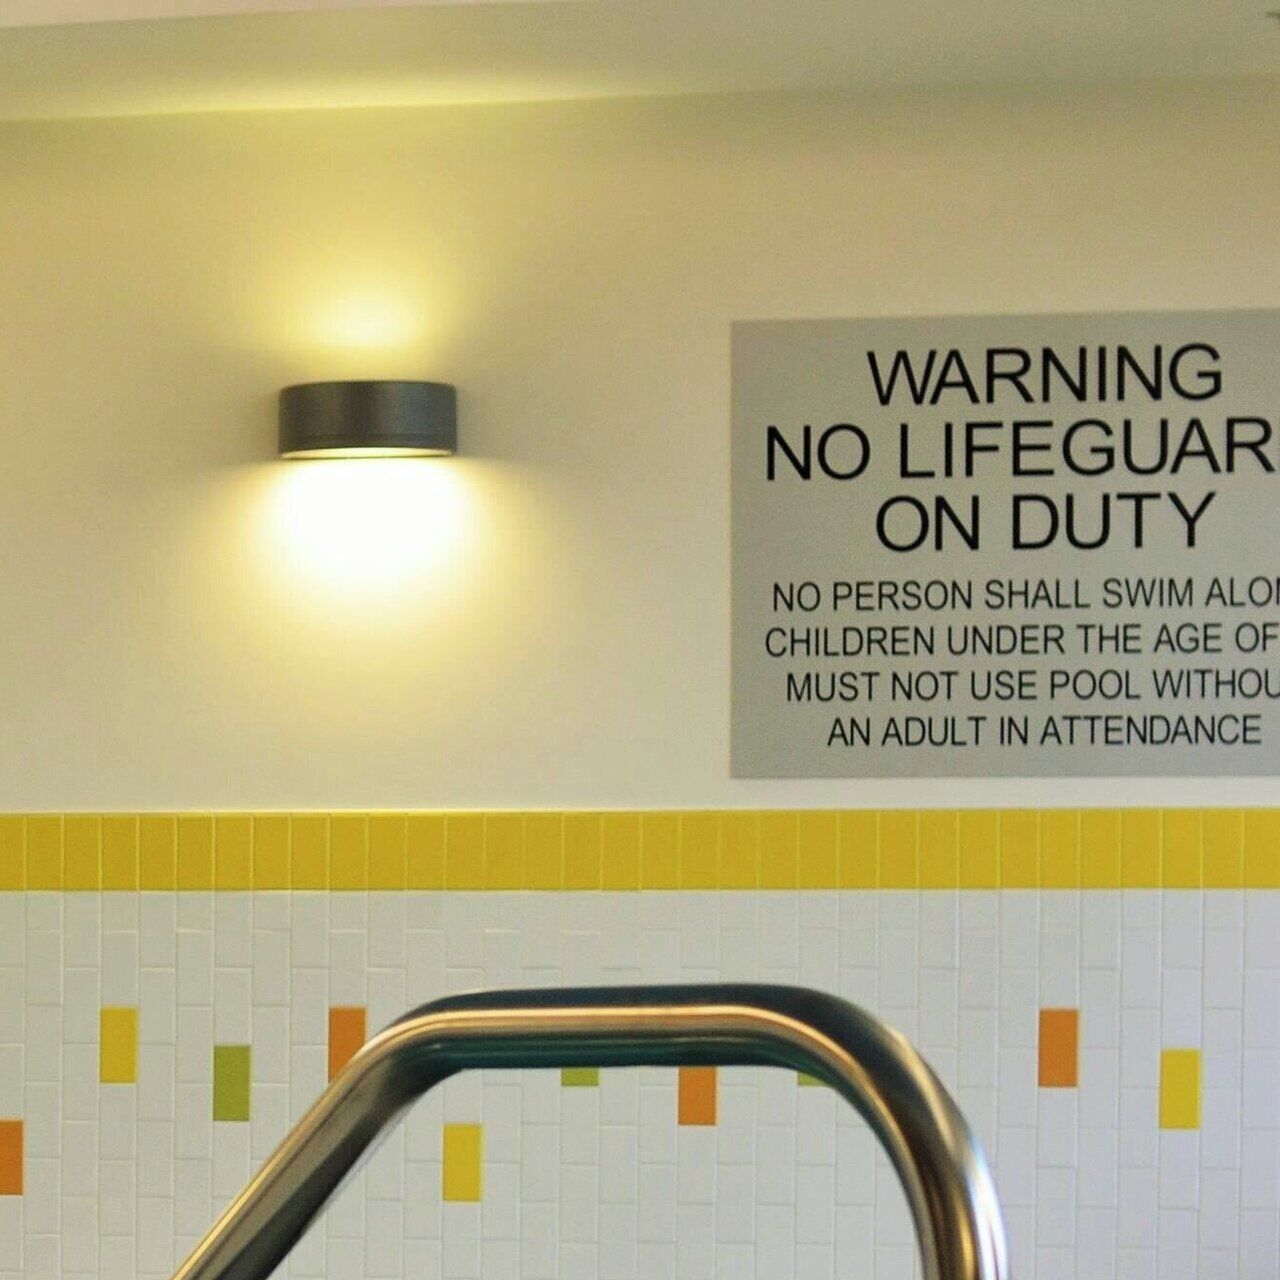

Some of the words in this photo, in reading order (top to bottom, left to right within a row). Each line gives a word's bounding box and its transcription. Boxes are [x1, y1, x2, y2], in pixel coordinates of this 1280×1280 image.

[867, 343, 1221, 406] WARNING
[767, 424, 870, 481] NO
[900, 417, 1280, 478] LIFEGUAR
[876, 495, 979, 552] ON
[1013, 492, 1215, 550] DUTY
[774, 582, 820, 611] NO
[833, 580, 971, 611] PERSON
[985, 579, 1090, 609] SHALL
[1103, 578, 1193, 608] SWIM
[1205, 576, 1280, 607] ALO
[766, 626, 934, 657] CHILDREN
[948, 625, 1064, 655] UNDER
[1077, 624, 1141, 653] THE
[1154, 623, 1222, 653] AGE
[1235, 623, 1279, 653] OF
[787, 672, 880, 702] MUST
[892, 671, 958, 701] NOT
[971, 670, 1037, 700] USE
[1051, 670, 1140, 700] POOL
[828, 718, 870, 746] AN
[882, 716, 986, 746] ADULT
[1000, 716, 1028, 745] IN
[1040, 715, 1261, 745] ATTENDANCE
